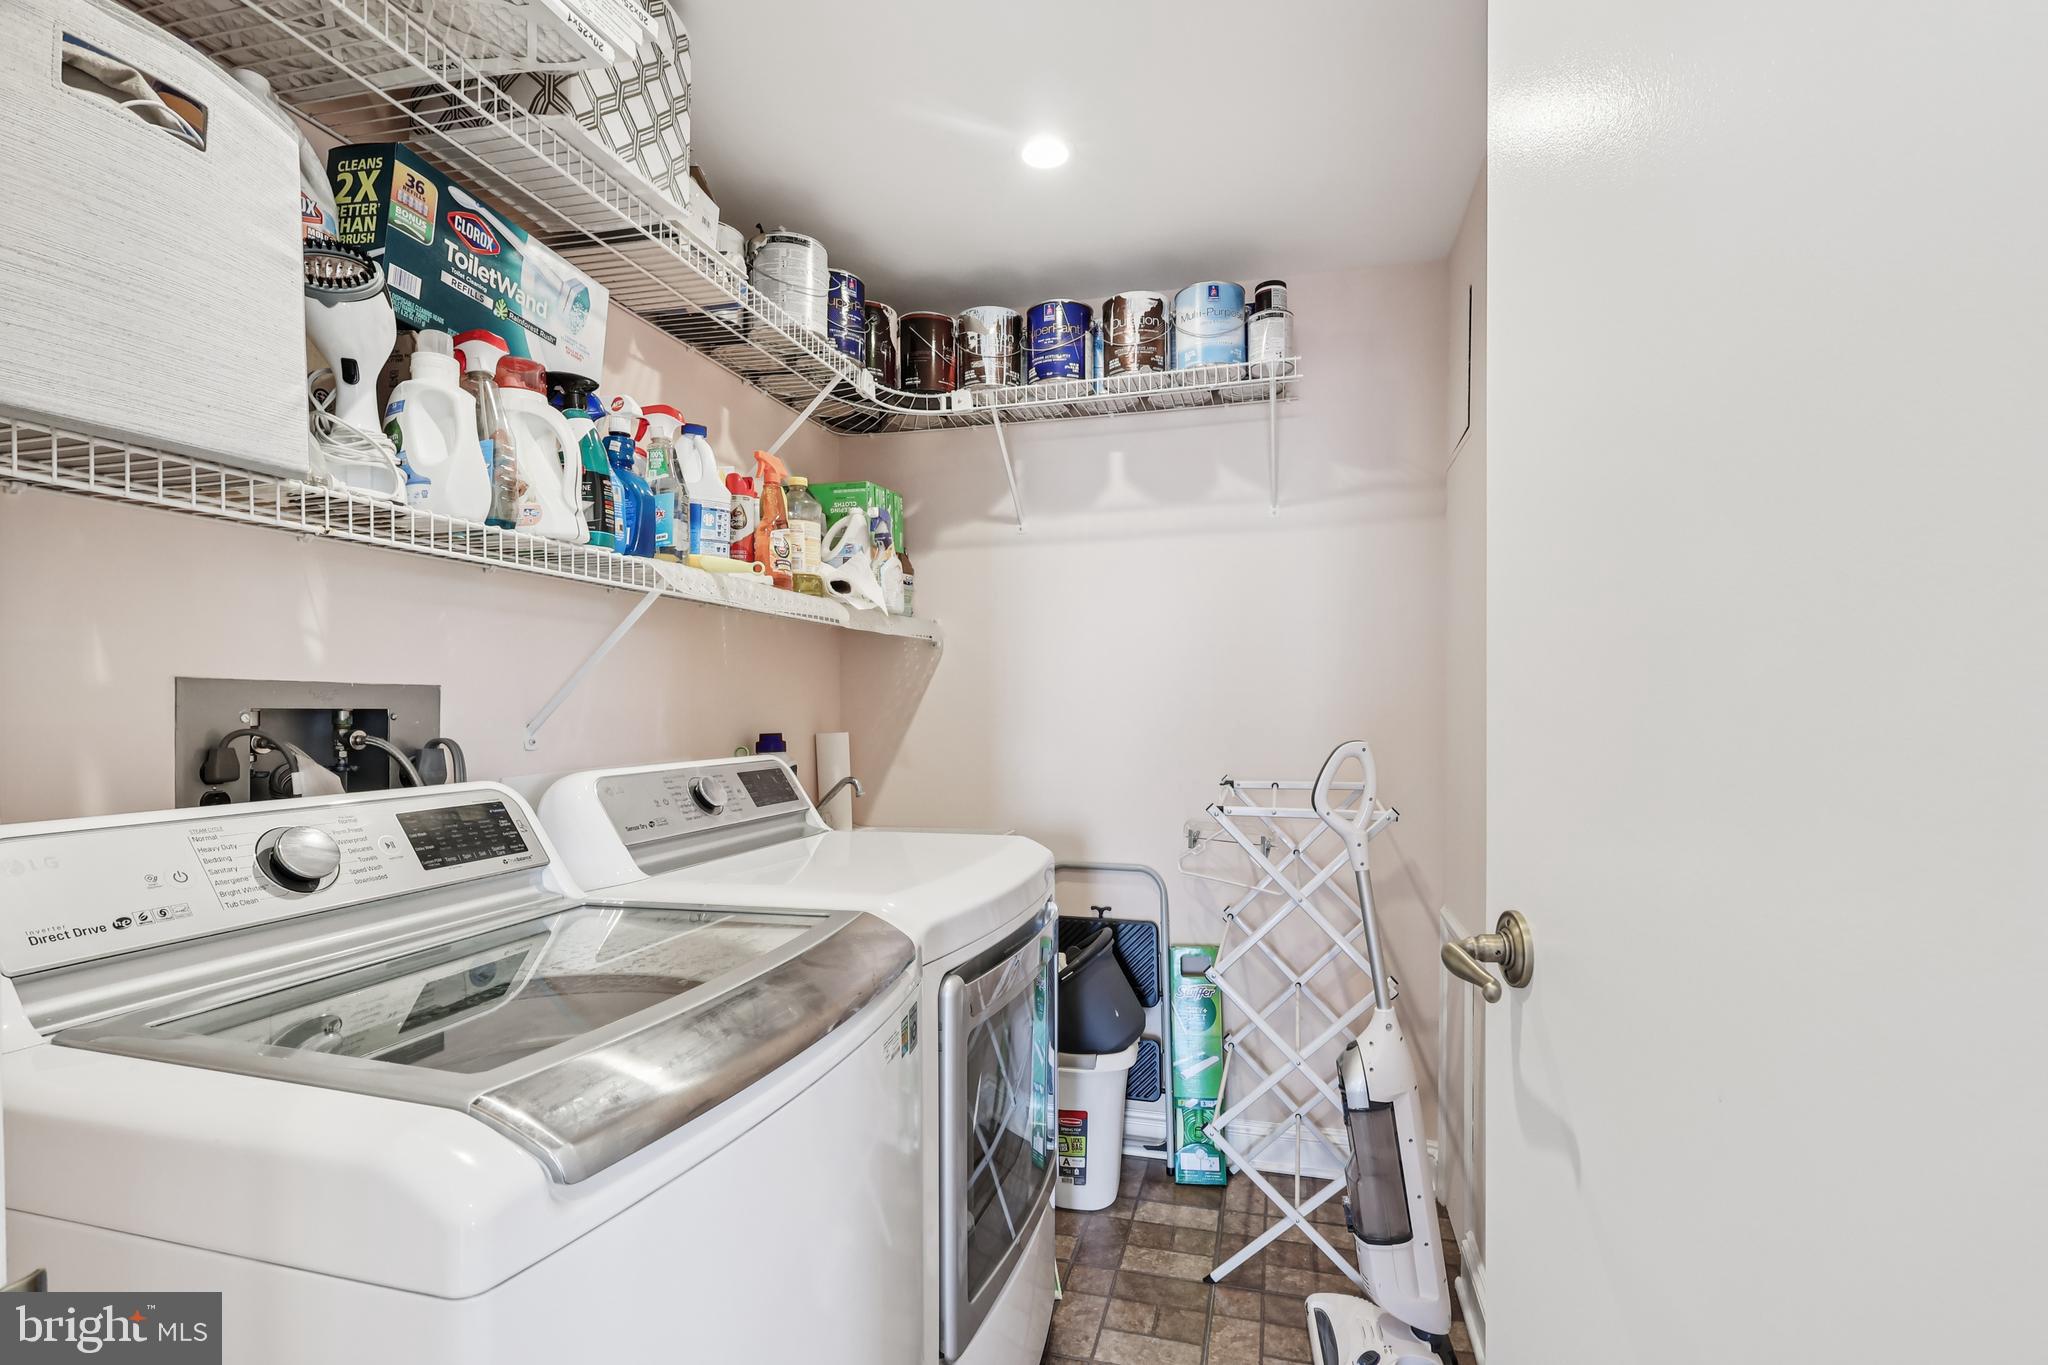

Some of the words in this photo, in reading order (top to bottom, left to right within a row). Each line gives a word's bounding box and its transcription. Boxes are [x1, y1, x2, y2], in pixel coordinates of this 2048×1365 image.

[337, 156, 383, 172] CLEANS
[335, 169, 381, 205] 2X
[405, 172, 425, 195] 36
[402, 185, 426, 202] REFILLS
[340, 216, 377, 234] HAN
[395, 205, 427, 230] BONUS
[454, 215, 495, 253] CLOROX
[444, 238, 549, 319] ToiletWand
[451, 267, 465, 280] Toilet
[465, 276, 488, 294] Cleaning
[451, 279, 485, 303] REFILLS
[508, 312, 540, 335] Rainforest
[539, 329, 556, 344] Rush
[191, 834, 218, 843] Normal
[197, 846, 220, 855] Heavy
[220, 843, 237, 852] Duty
[202, 855, 233, 865] Bedding
[207, 865, 238, 876] Sanitary
[219, 888, 241, 898] Bright
[224, 900, 239, 909] Tub
[239, 897, 260, 907] Clean
[25, 924, 65, 936] Inverter
[28, 930, 71, 946] Direct
[72, 924, 107, 938] Drive
[1176, 985, 1216, 1001] Swiffer
[1062, 1157, 1071, 1166] A
